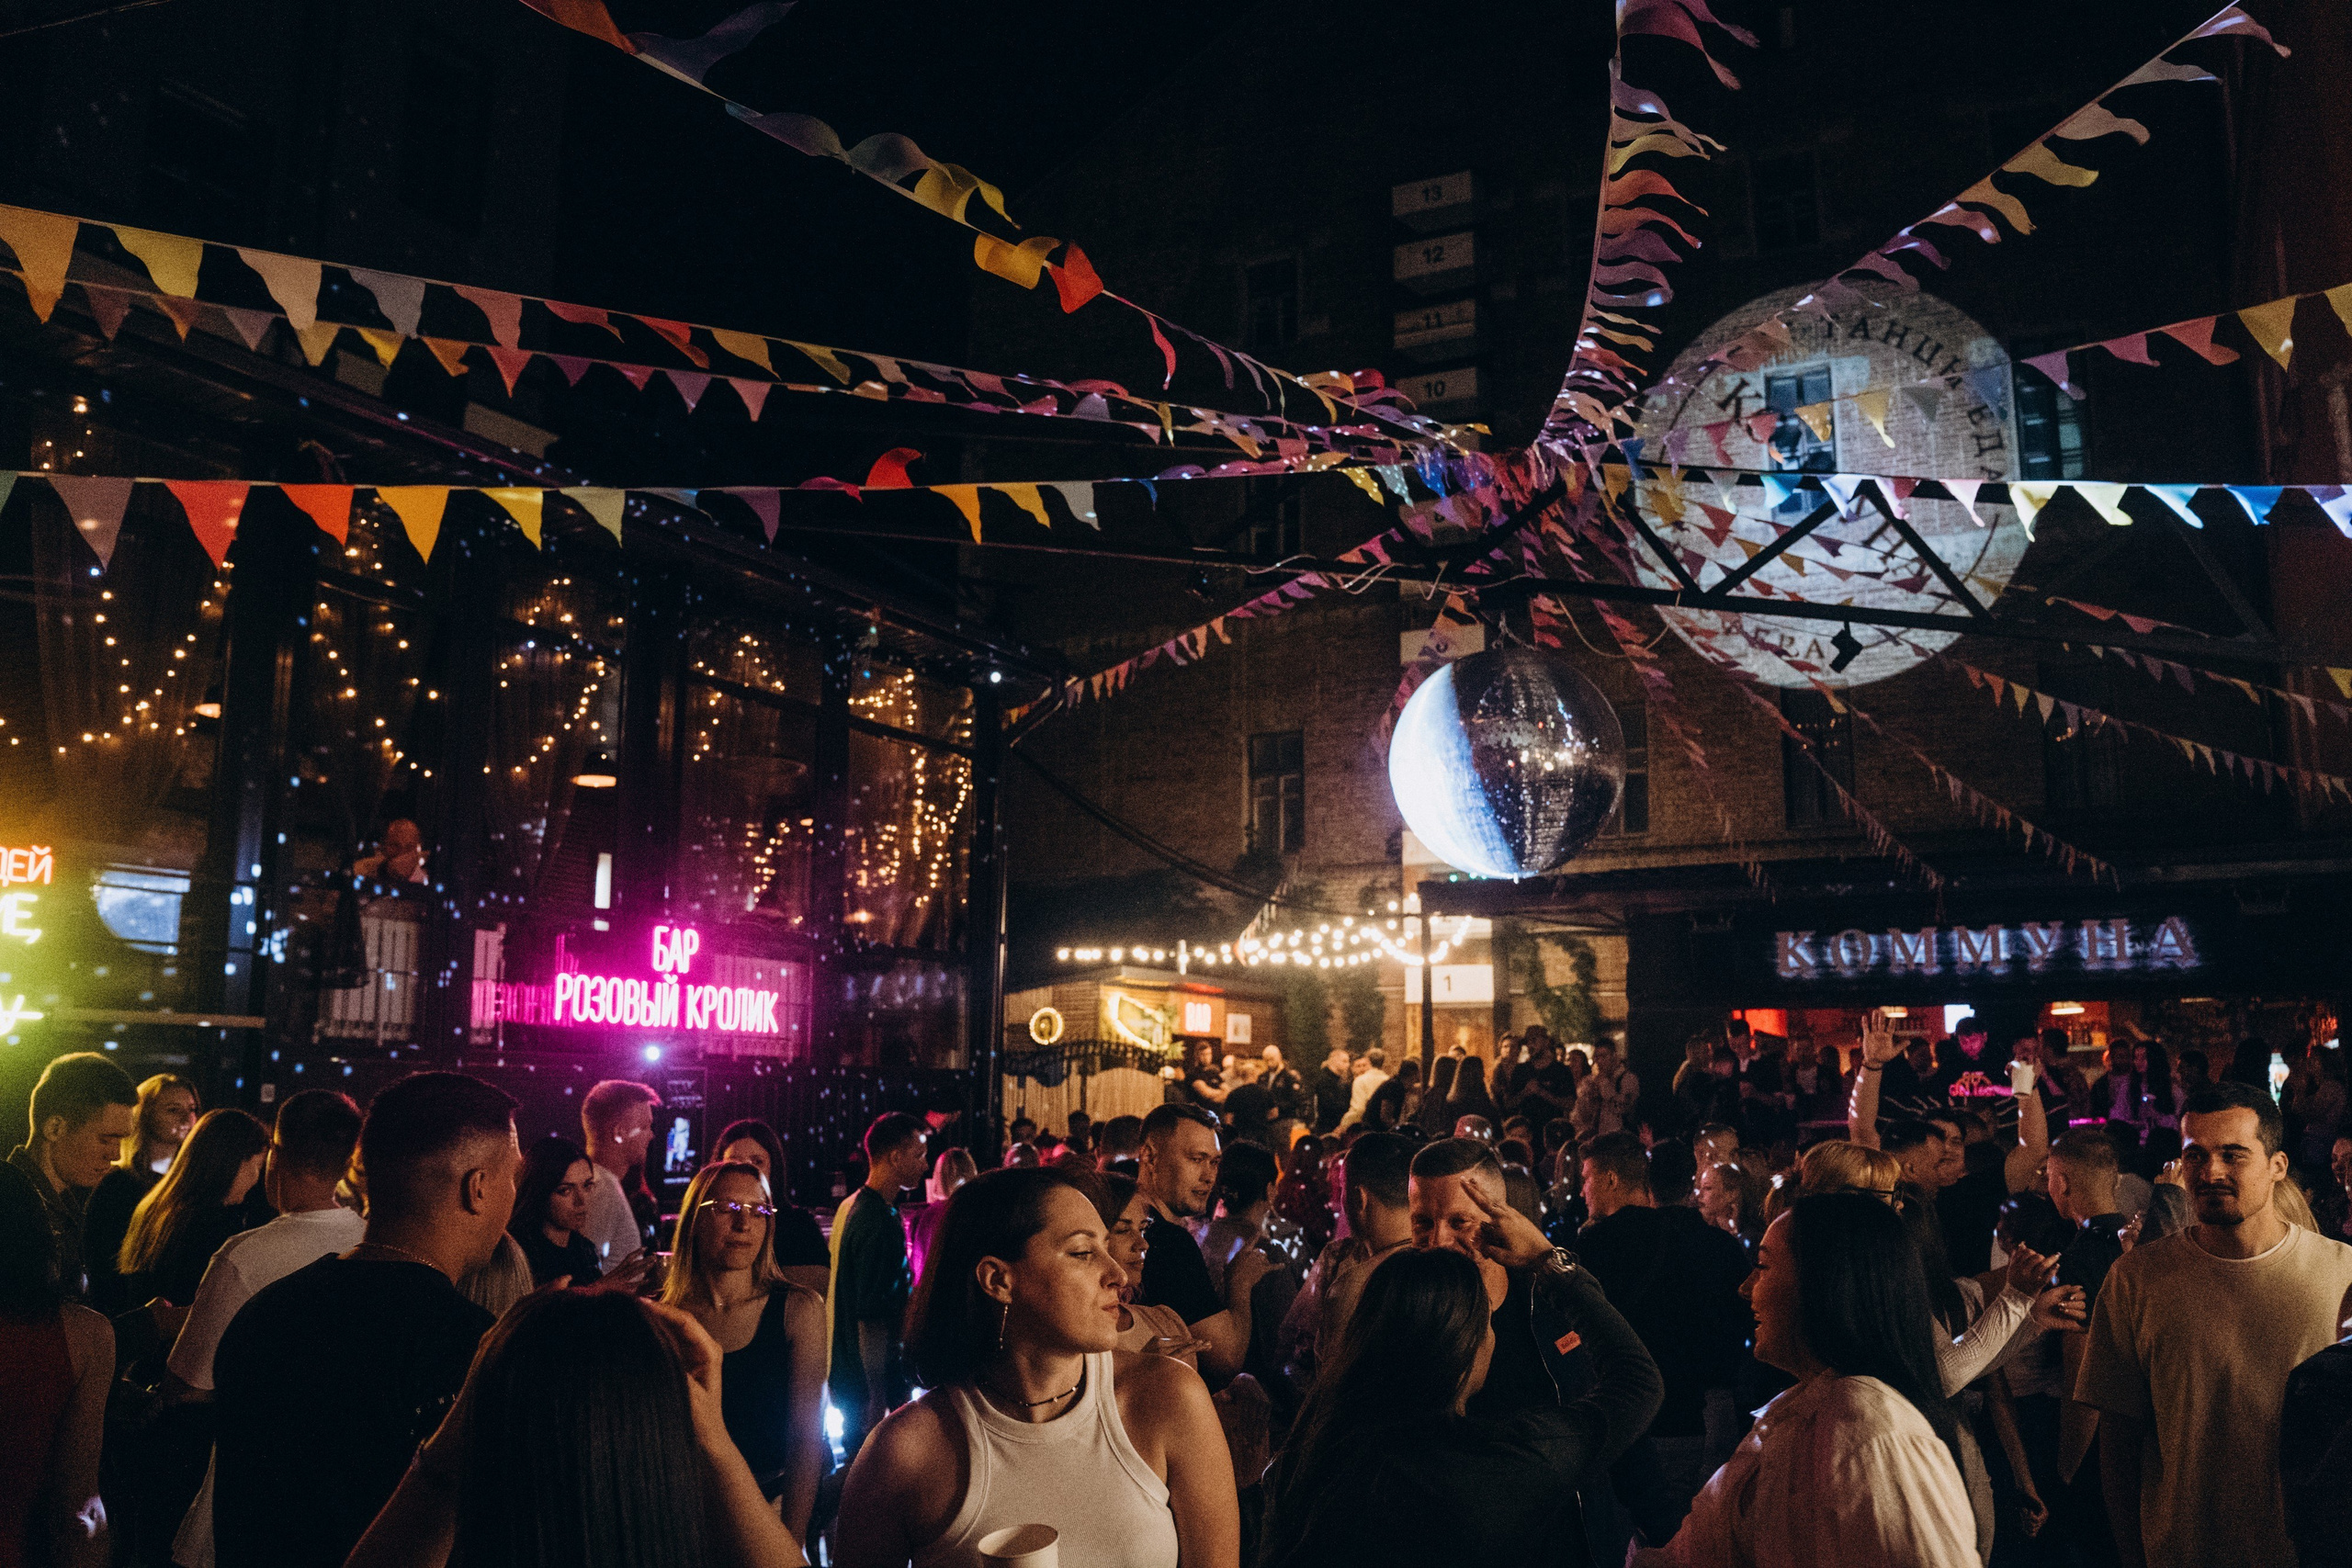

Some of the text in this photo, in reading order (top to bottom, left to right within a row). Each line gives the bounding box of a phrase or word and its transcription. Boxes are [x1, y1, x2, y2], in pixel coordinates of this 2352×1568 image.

[1422, 185, 1442, 202] 13
[1422, 245, 1444, 264] 12
[1424, 311, 1442, 329] 11
[1424, 380, 1445, 398] 10
[653, 925, 699, 974] БАР
[1775, 917, 2201, 975] КОММУНА
[1443, 975, 1452, 992] 1
[554, 973, 779, 1033] РОЗОВЫЙ КРОЛИК
